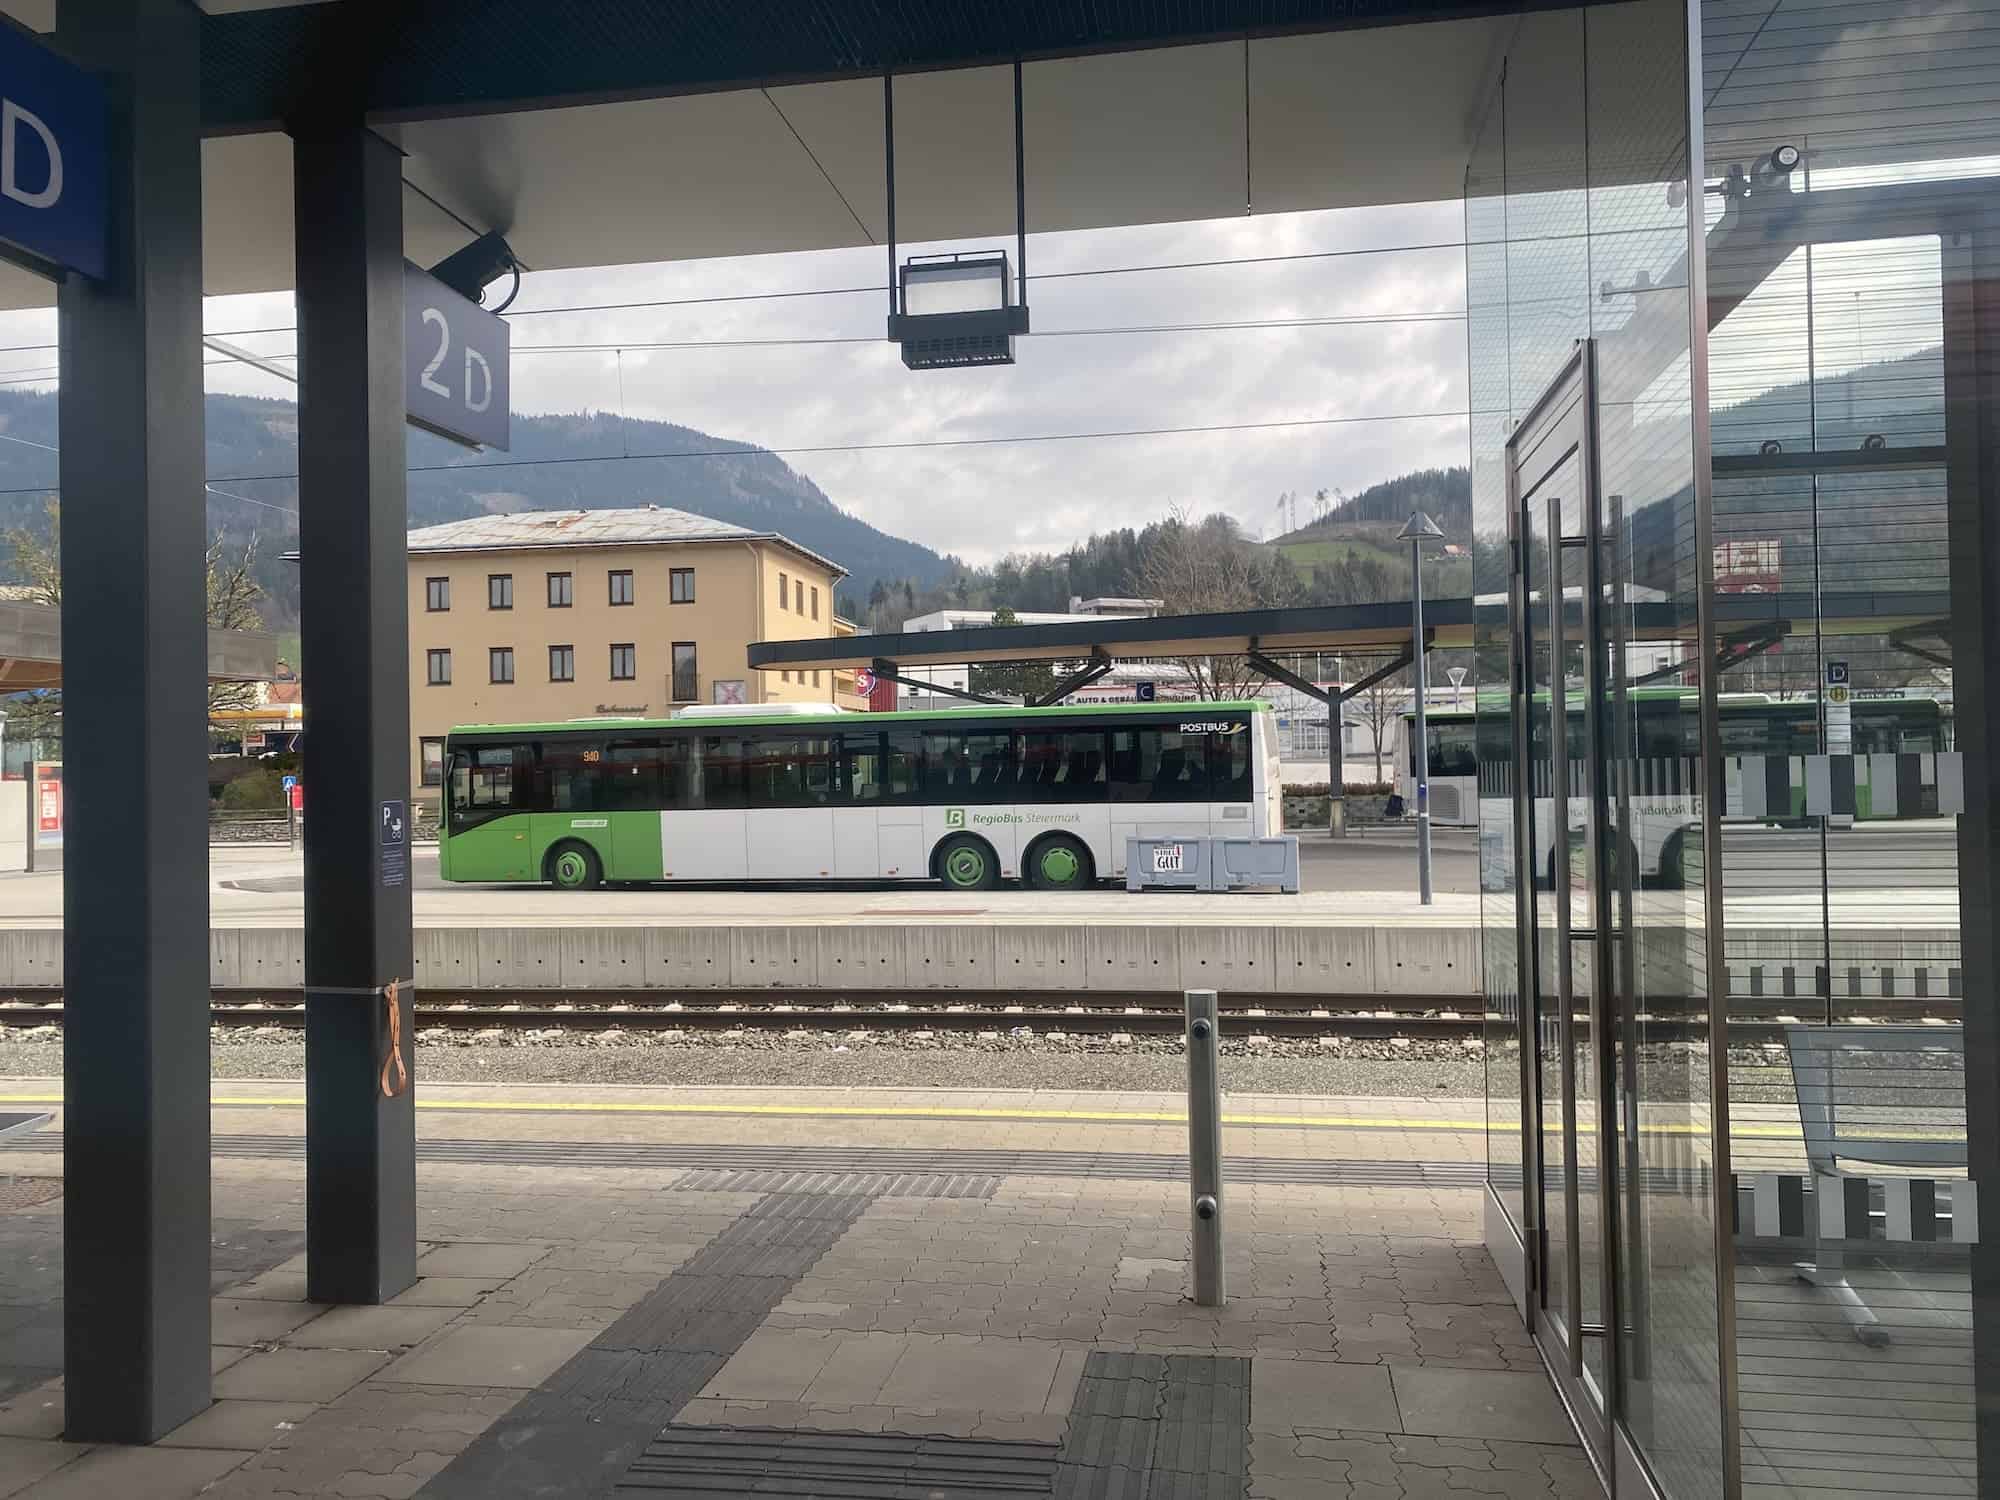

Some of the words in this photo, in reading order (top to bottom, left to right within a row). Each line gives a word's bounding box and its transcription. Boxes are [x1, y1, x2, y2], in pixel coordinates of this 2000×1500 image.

[0, 97, 64, 209] D
[420, 307, 451, 399] 2
[464, 346, 493, 413] D
[1832, 665, 1845, 681] D
[1140, 685, 1151, 699] C
[1077, 696, 1099, 704] AUTO
[1180, 722, 1229, 733] POSTBUS
[583, 750, 600, 762] 940
[383, 807, 391, 826] P
[973, 813, 1023, 826] RegioBus
[1025, 812, 1081, 824] Steiermark
[1157, 855, 1180, 869] GUT
